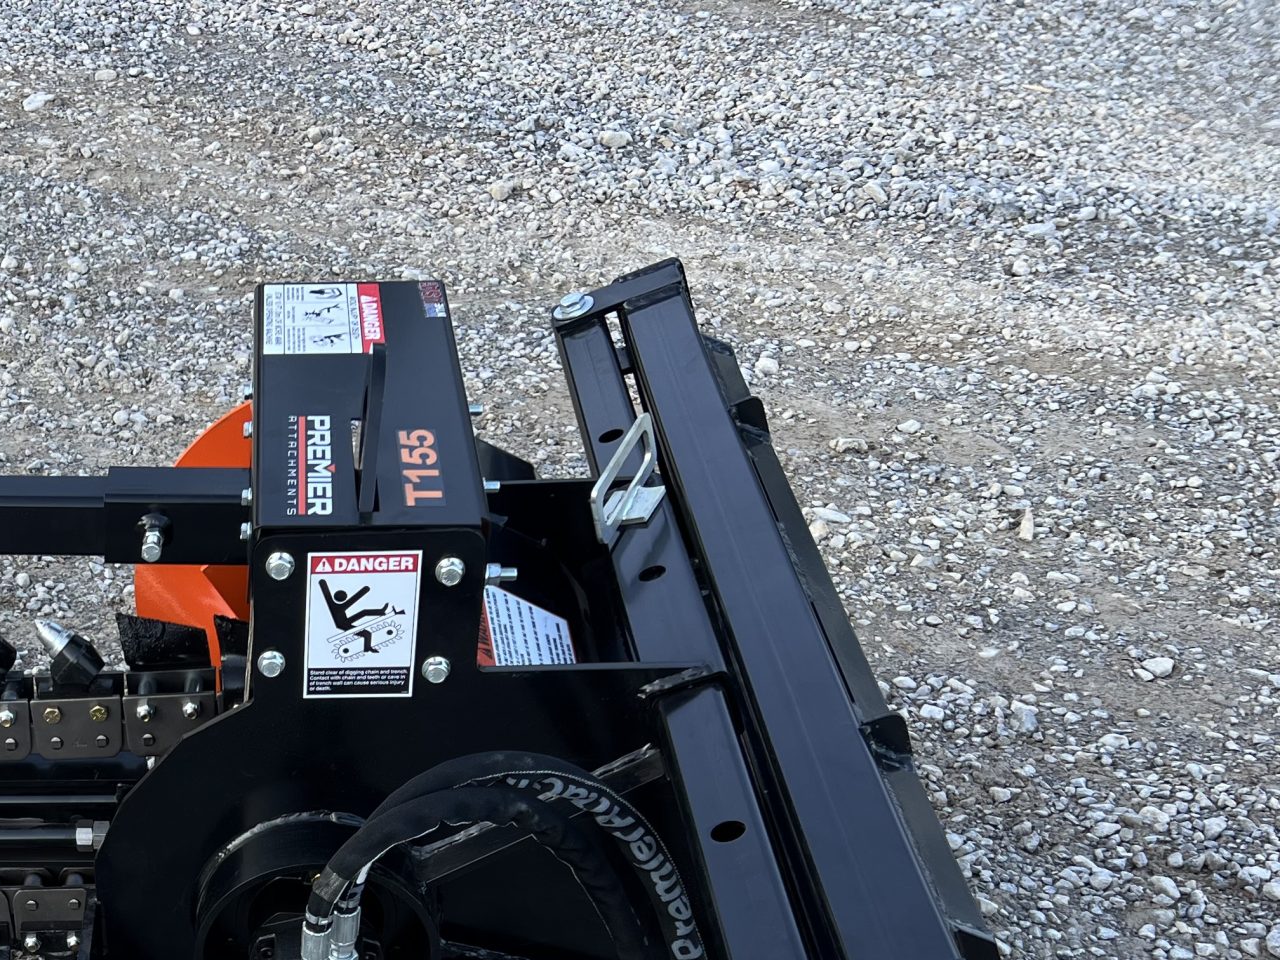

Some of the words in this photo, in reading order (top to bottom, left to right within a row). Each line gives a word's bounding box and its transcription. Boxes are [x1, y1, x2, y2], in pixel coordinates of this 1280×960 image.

[362, 302, 381, 340] DANGER
[287, 415, 297, 516] ATTACHMENTS
[307, 415, 335, 516] PREMIER
[399, 429, 443, 507] T155
[334, 557, 413, 572] DANGER
